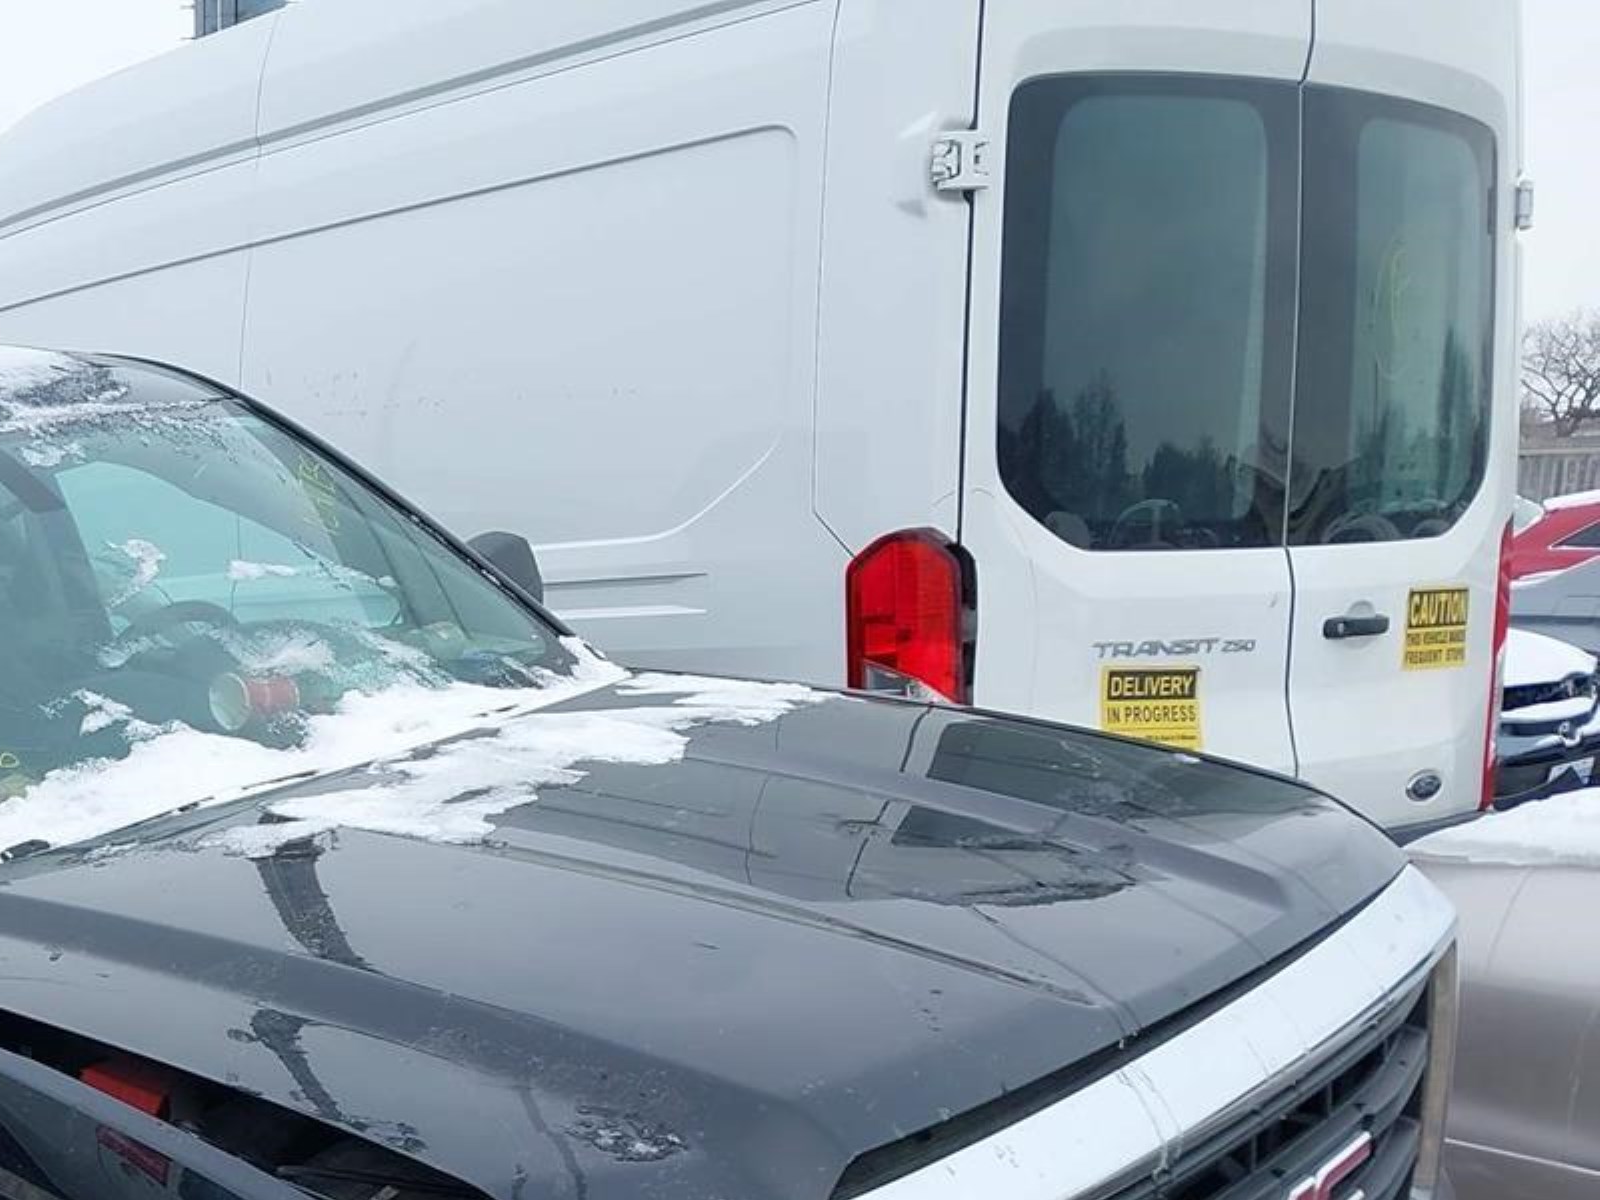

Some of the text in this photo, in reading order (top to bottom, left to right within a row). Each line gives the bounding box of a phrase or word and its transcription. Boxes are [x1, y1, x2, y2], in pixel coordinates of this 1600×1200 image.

[1410, 592, 1466, 626] CAUTION
[1092, 637, 1256, 658] TRANSIT 250
[1110, 674, 1194, 697] DELIVERY
[1107, 704, 1196, 723] IN PROGRESS
